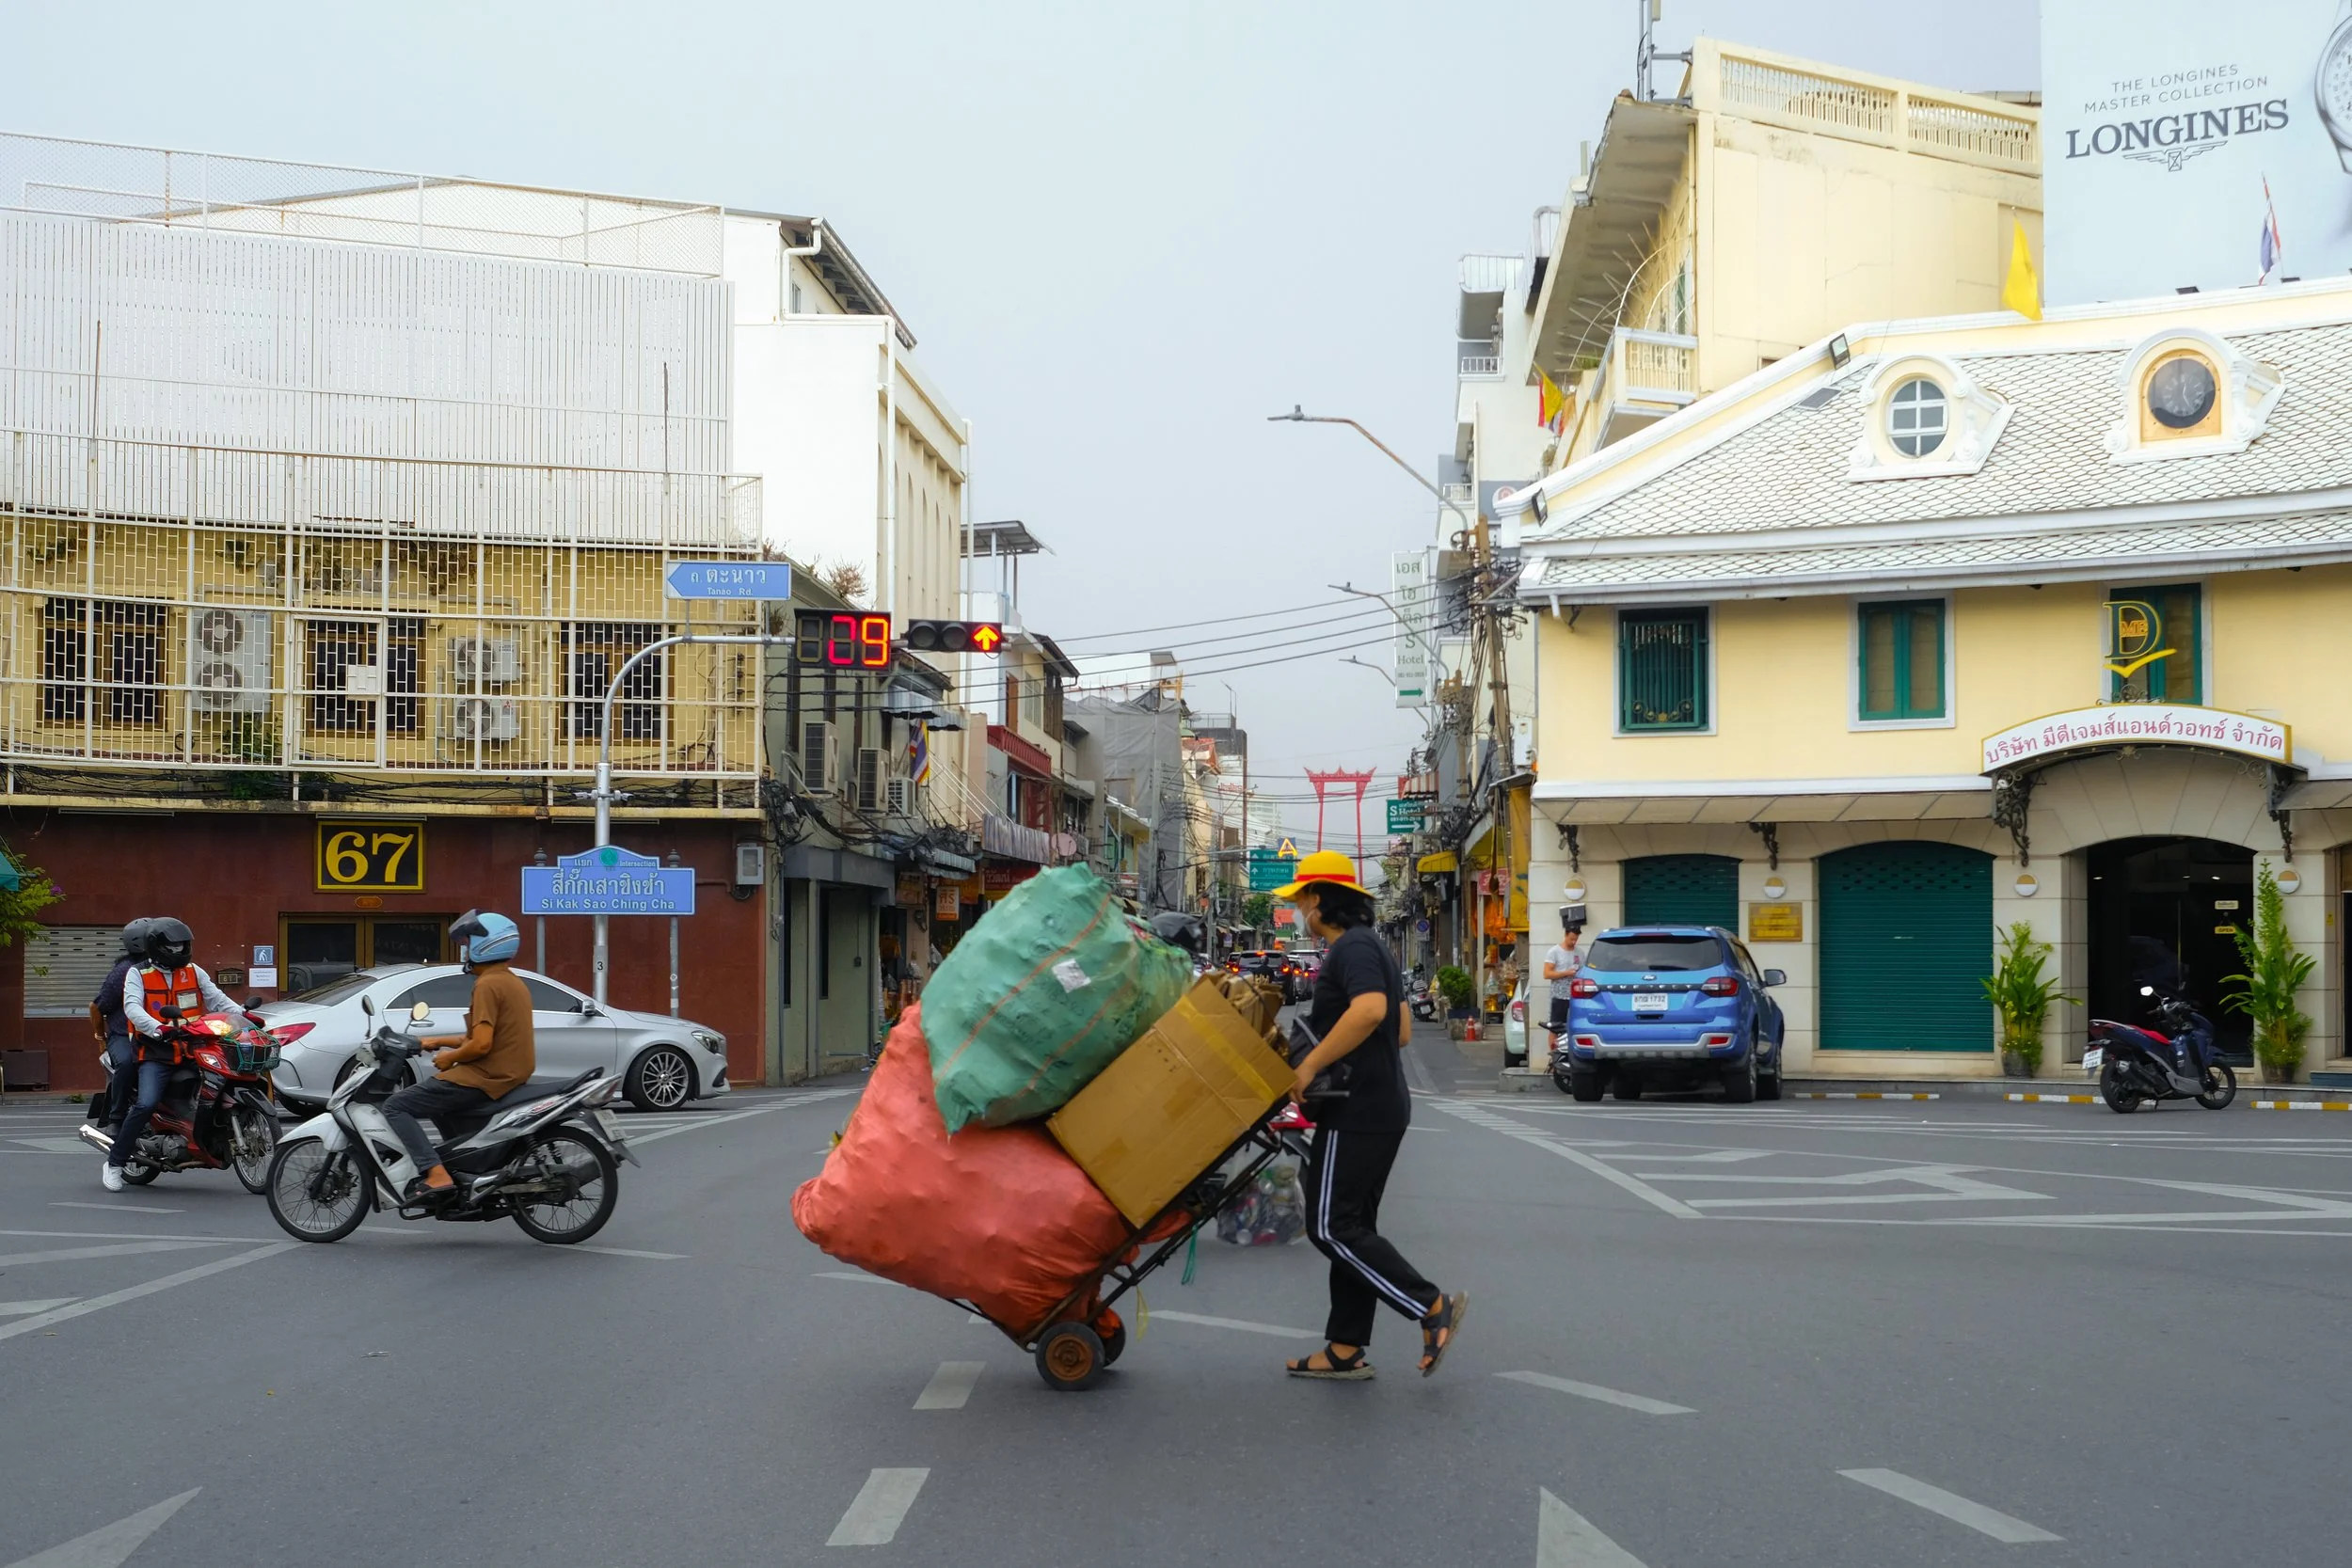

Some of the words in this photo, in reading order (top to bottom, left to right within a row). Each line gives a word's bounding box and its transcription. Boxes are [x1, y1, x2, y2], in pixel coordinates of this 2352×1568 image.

[2111, 79, 2144, 93] THE
[2152, 64, 2238, 87] LONGINES
[2084, 96, 2151, 114] MASTER
[2158, 76, 2268, 103] COLLECTION
[2066, 98, 2289, 159] LONGINES
[707, 567, 767, 584] ตะนาว
[707, 587, 732, 595] Tanao
[739, 587, 754, 595] Rd.
[1405, 634, 1416, 648] S
[1397, 655, 1424, 664] Hotel
[1985, 736, 2038, 765] บริษัท
[2042, 712, 2229, 748] มีดีเจมส์แอนด์วอทช์
[2232, 724, 2283, 752] จำกัด
[1390, 805, 1397, 816] S
[326, 831, 415, 883] 67
[574, 858, 593, 866] แยก
[541, 898, 553, 910] Si
[556, 898, 579, 910] Kak
[583, 898, 607, 910] Sao
[612, 898, 647, 911] Ching
[651, 898, 675, 910] Cha
[596, 960, 604, 971] 3
[180, 970, 189, 983] 2
